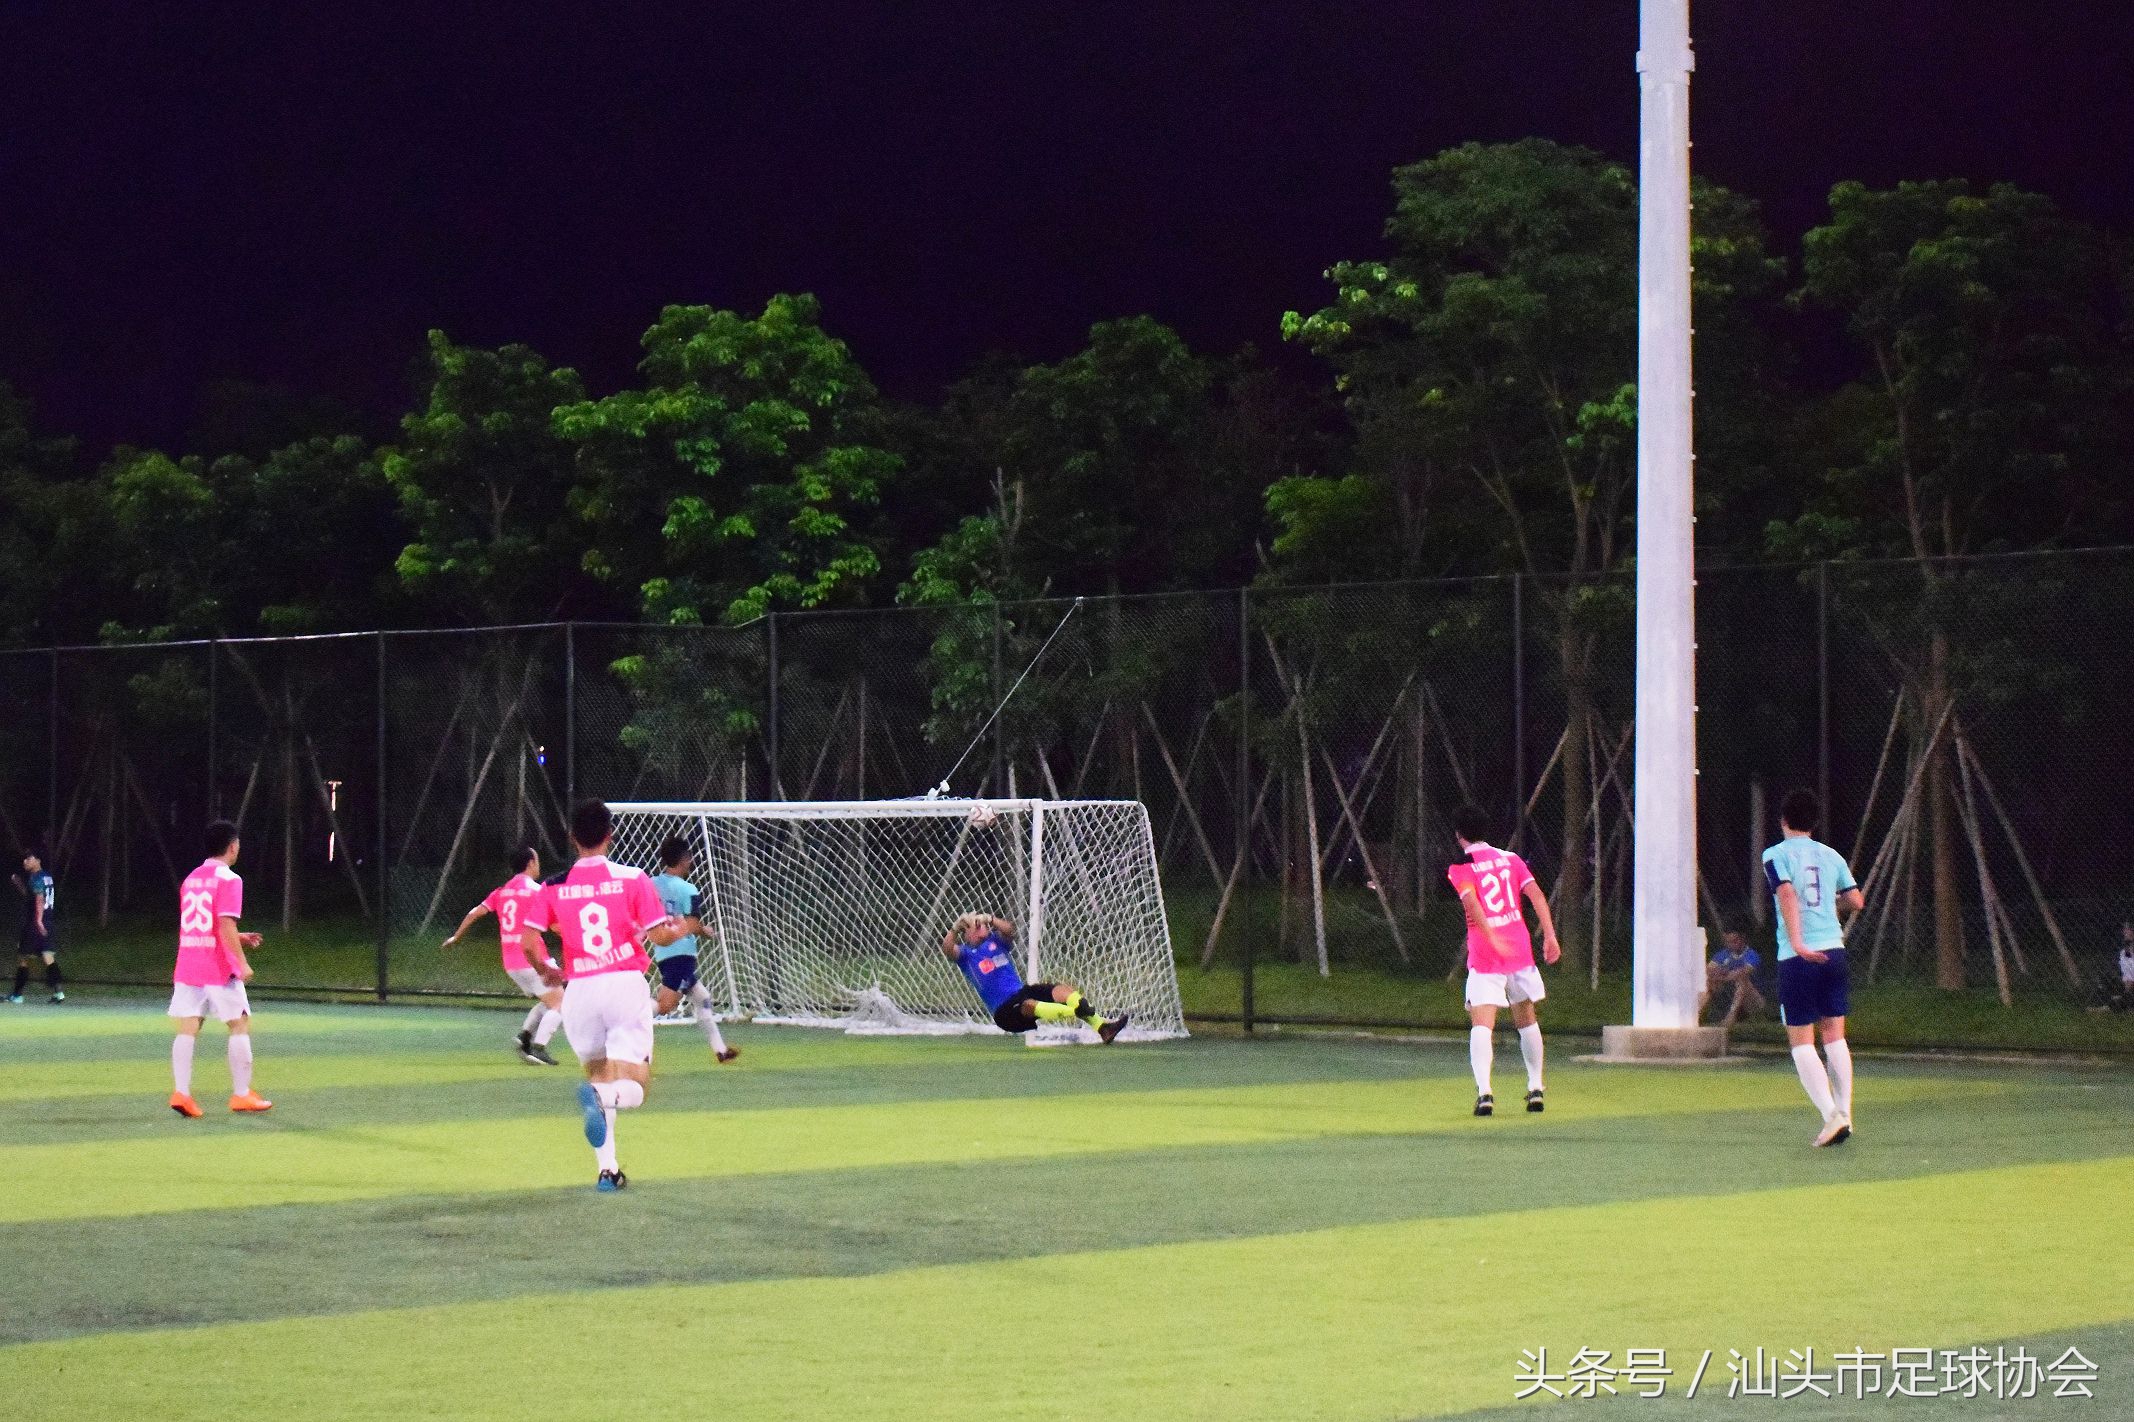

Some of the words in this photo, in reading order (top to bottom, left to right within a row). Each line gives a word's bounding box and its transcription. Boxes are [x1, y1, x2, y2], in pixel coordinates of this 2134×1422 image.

[1480, 869, 1517, 914] 21
[1803, 866, 1820, 908] 3
[503, 899, 517, 931] 3
[580, 901, 612, 957] 8
